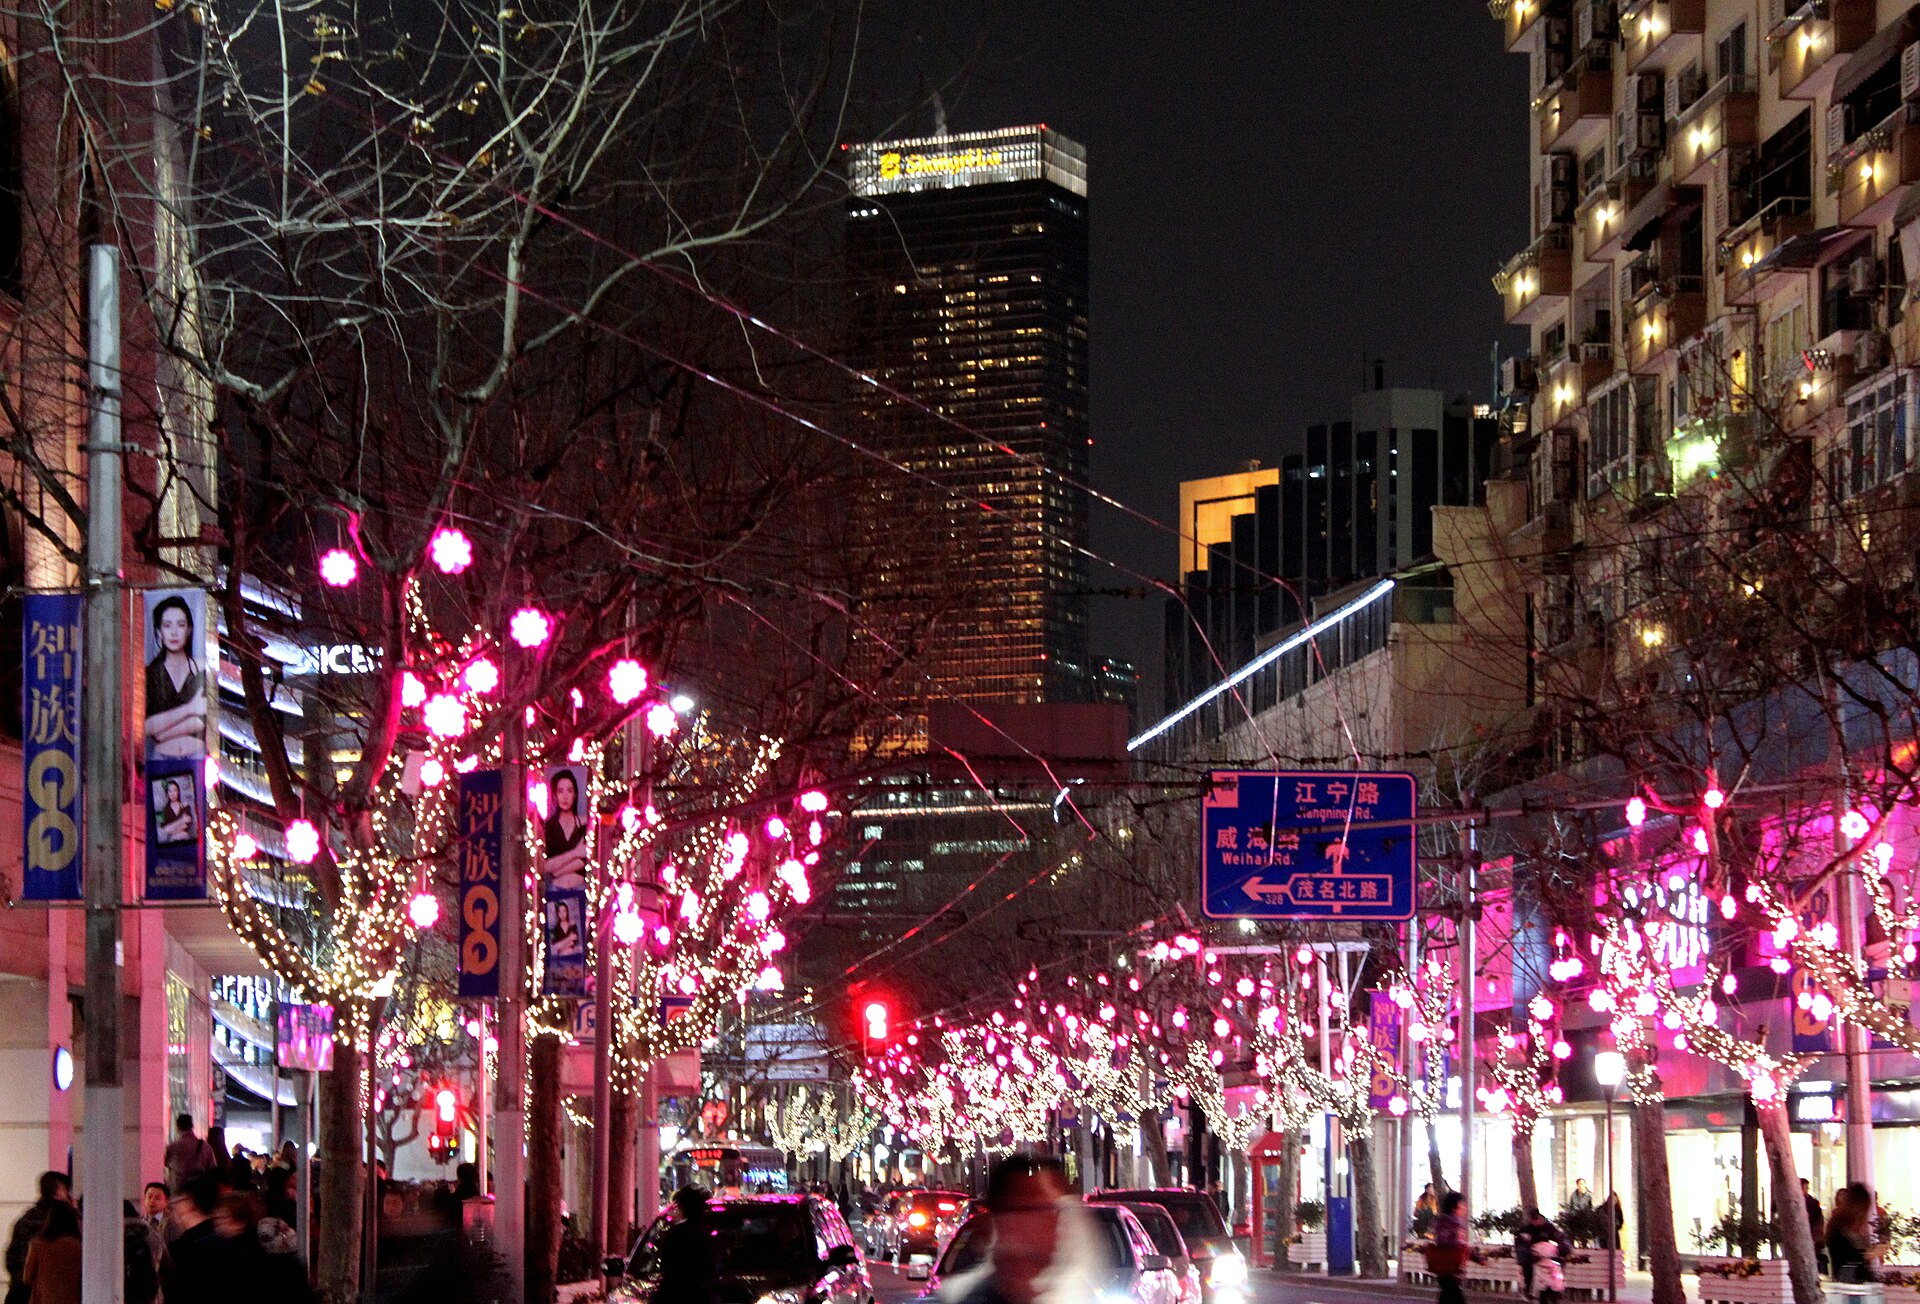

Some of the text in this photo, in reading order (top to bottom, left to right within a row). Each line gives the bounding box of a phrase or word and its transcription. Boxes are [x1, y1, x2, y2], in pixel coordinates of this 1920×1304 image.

[29, 620, 80, 745] 智族
[1295, 782, 1379, 804] 江宁路
[1355, 807, 1374, 820] Rd.
[464, 790, 499, 882] 智族
[1222, 852, 1267, 865] Weihai
[1297, 880, 1378, 899] 茂名北路
